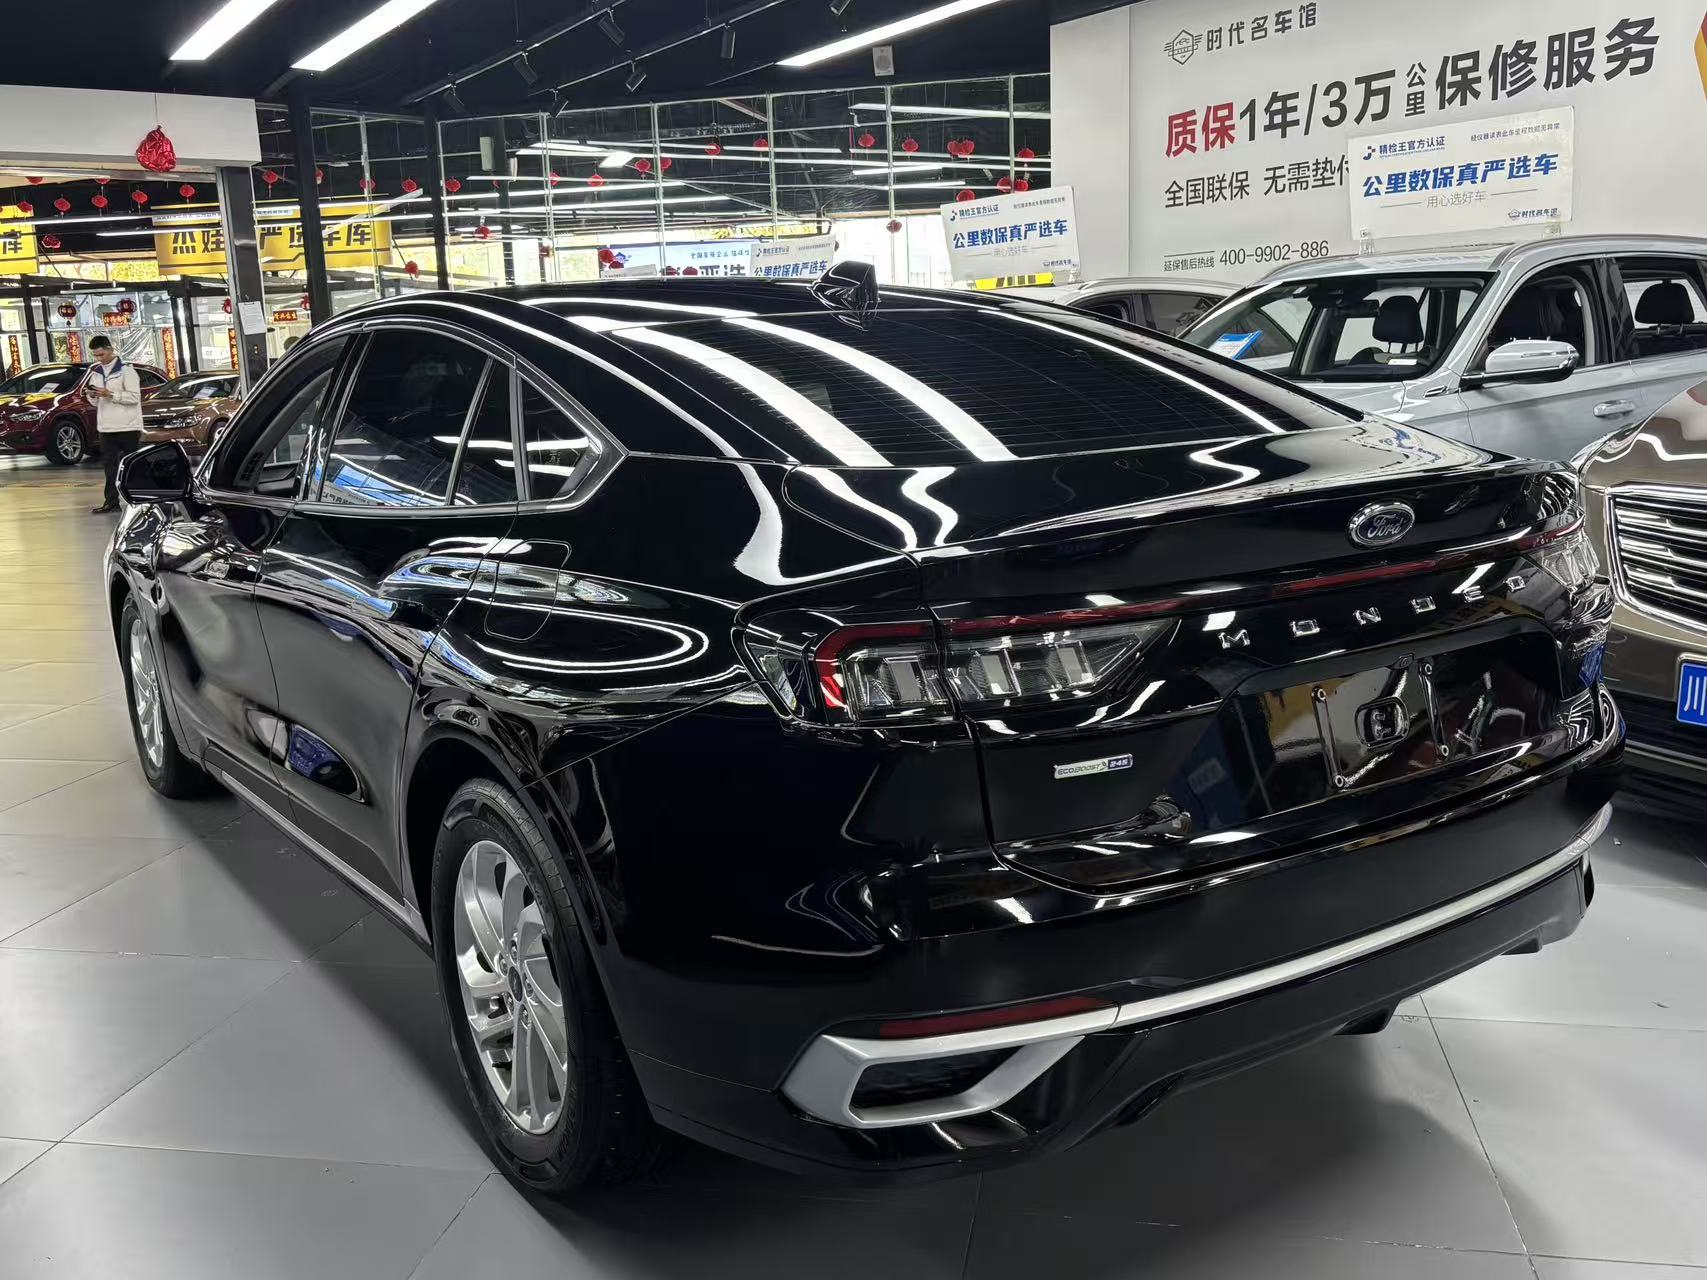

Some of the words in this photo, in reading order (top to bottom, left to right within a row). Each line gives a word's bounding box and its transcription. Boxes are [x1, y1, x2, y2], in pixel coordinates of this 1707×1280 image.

[1206, 2, 1317, 51] 时代名车馆
[1165, 171, 1250, 208] 全国联保
[1362, 153, 1559, 198] 公里数保真严选车
[1426, 189, 1487, 209] 用心选好车
[953, 218, 1068, 249] 公里数保真严选车
[1219, 240, 1329, 266] 400-9902-886
[1367, 513, 1405, 538] Ford
[1218, 575, 1525, 649] MONDEO
[1109, 758, 1129, 768] 245
